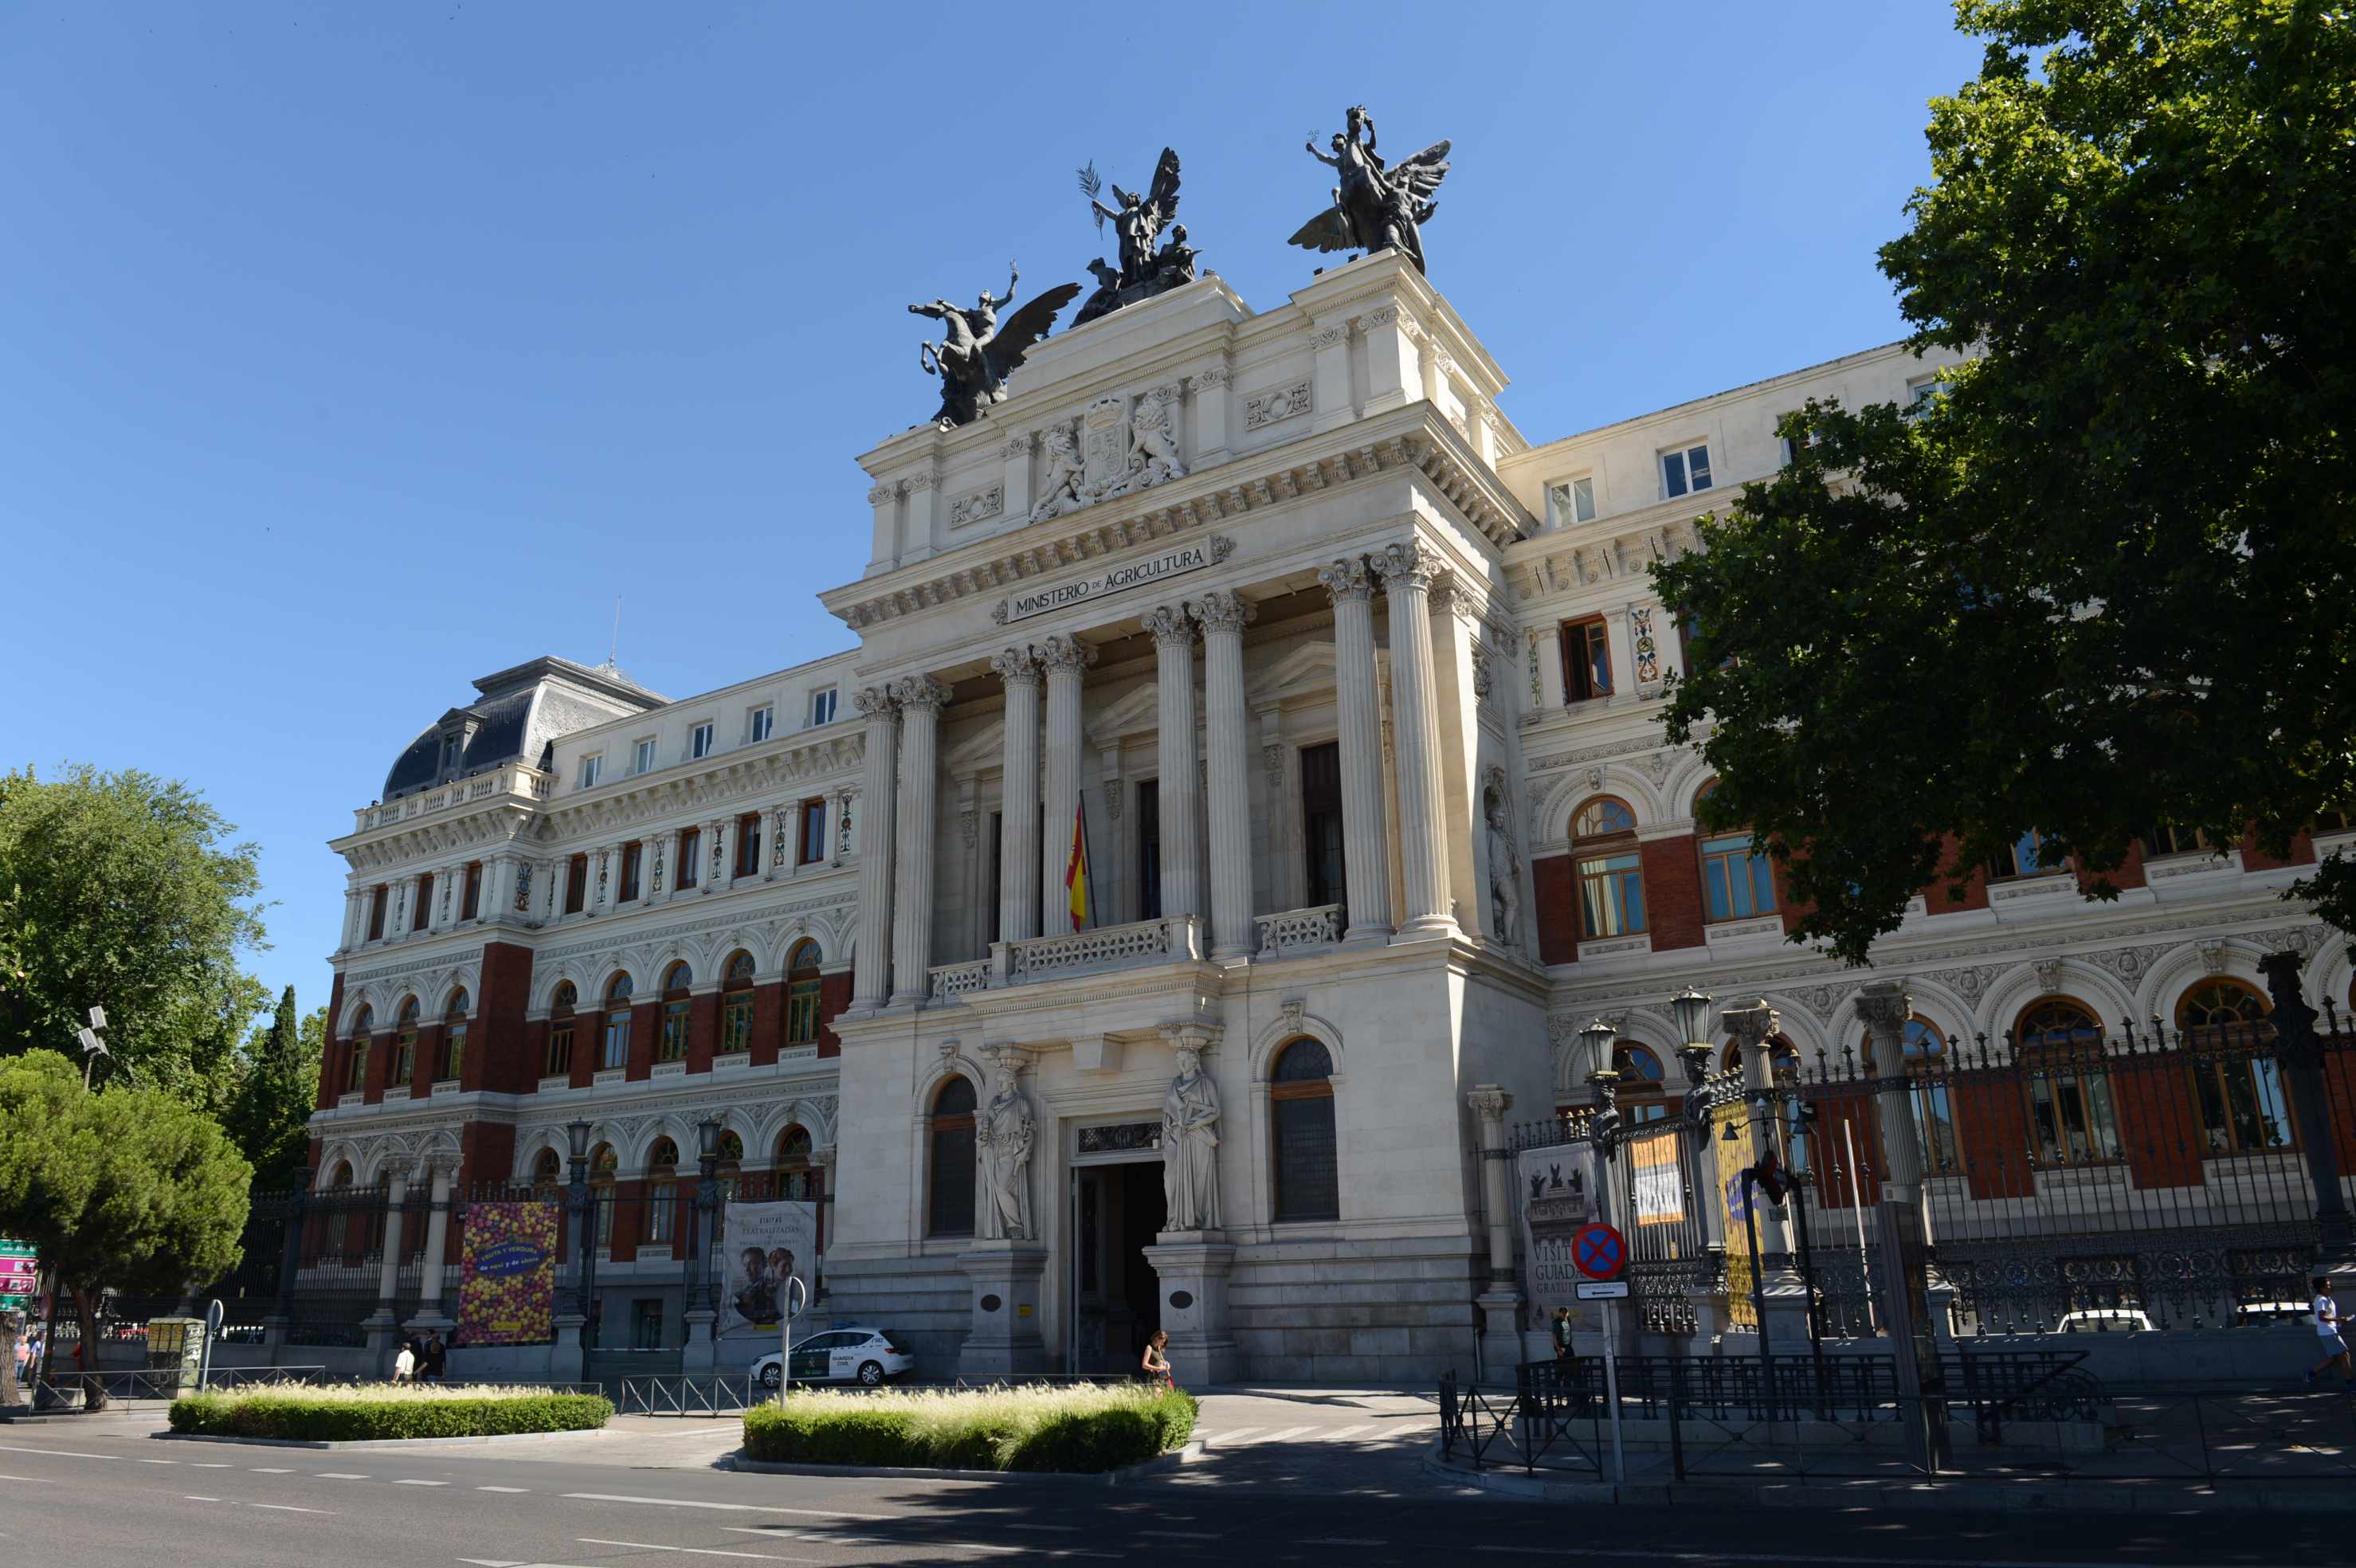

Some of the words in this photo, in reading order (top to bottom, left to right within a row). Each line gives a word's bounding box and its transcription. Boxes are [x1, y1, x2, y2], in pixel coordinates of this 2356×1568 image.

[1017, 582, 1088, 614] MINISTERIO
[1104, 548, 1204, 590] AGRICULTURA
[1535, 1246, 1570, 1261] VISIT
